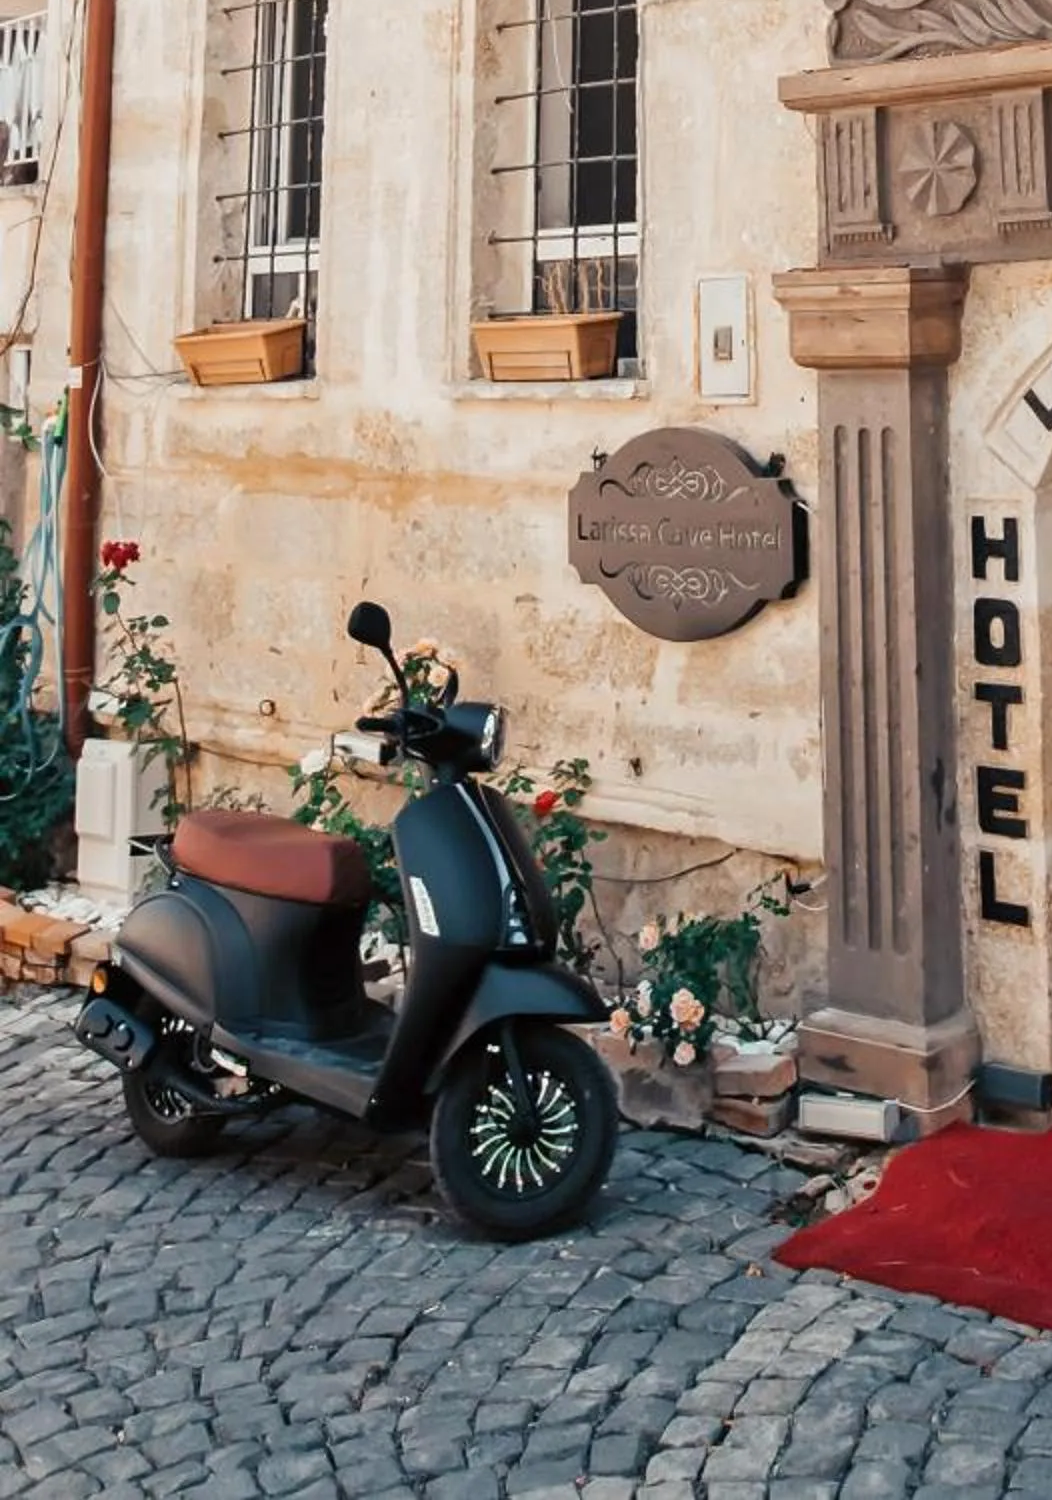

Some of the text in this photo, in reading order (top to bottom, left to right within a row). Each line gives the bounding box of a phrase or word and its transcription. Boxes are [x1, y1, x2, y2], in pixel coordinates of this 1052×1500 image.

[576, 512, 782, 551] Larissa Cave Hotel
[971, 515, 1033, 928] HOTEL
